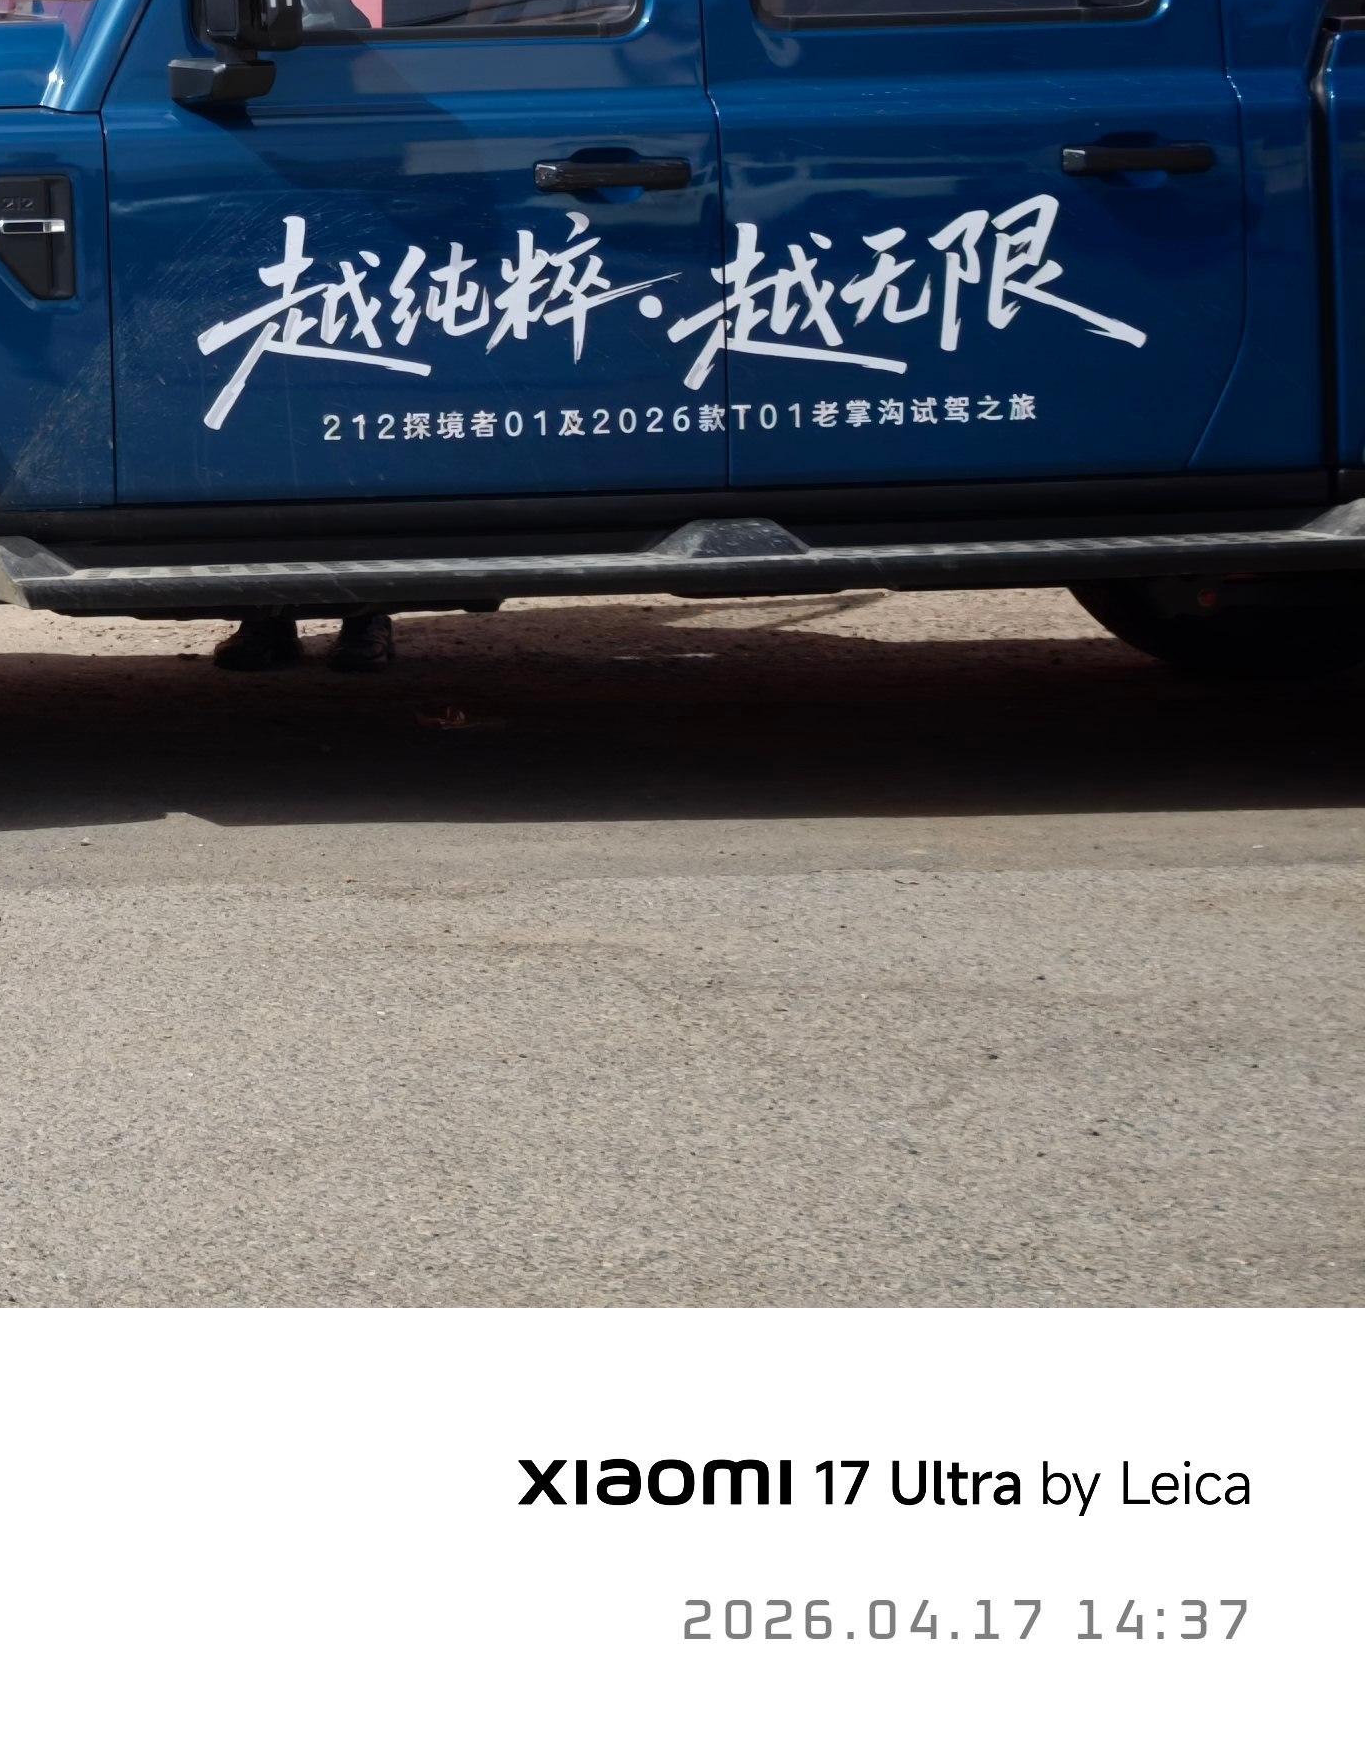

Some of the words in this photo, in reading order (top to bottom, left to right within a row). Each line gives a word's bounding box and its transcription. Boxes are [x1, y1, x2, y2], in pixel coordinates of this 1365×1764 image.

[323, 390, 1037, 442] 212探境者01及2026款T01老掌沟试驾之旅
